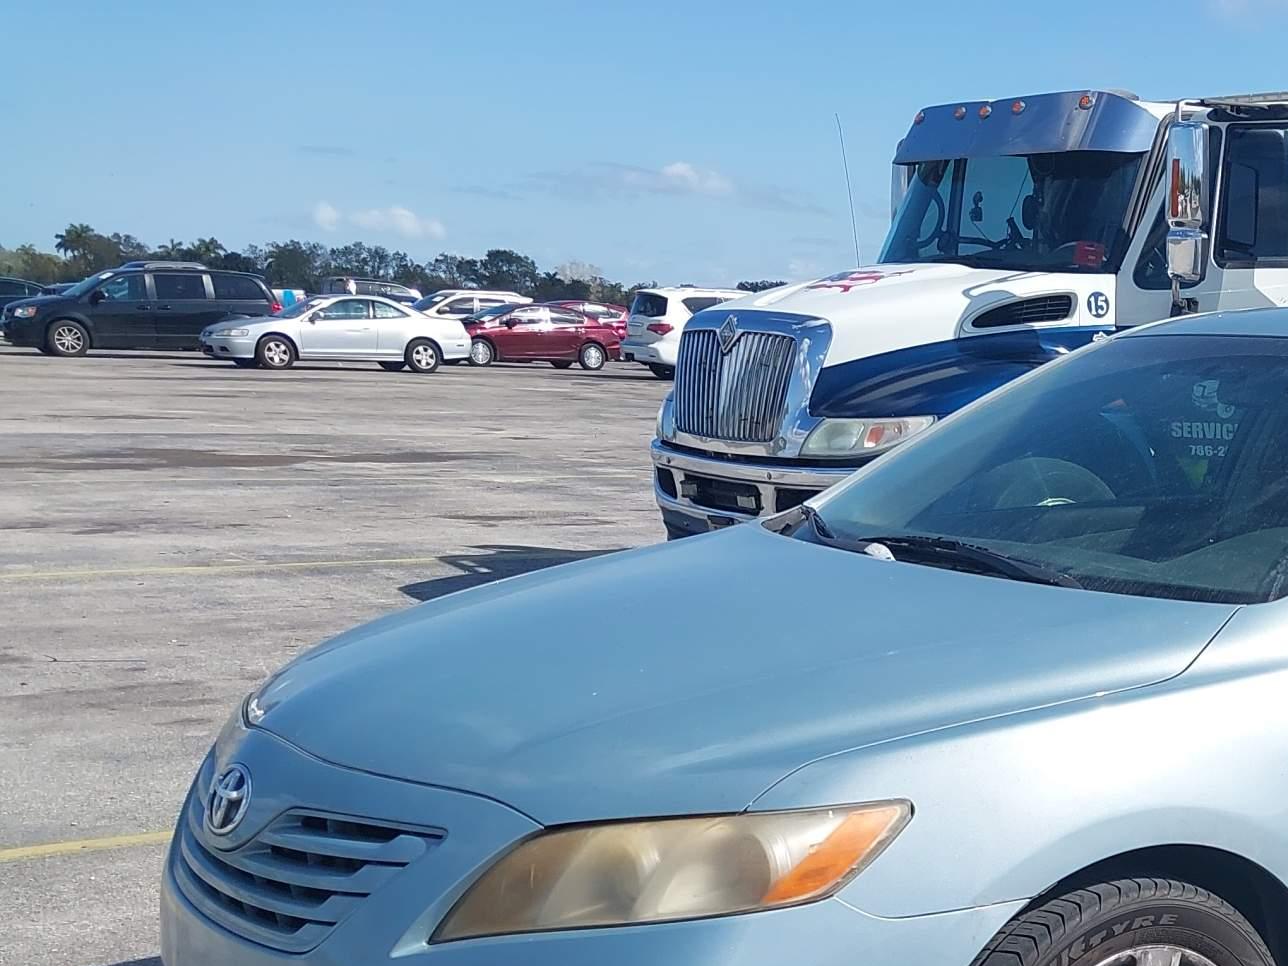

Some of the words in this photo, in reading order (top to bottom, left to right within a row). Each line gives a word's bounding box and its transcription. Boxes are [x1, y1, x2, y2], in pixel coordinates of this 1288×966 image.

[1089, 295, 1107, 315] 15
[1171, 422, 1238, 440] SERVIC
[1189, 444, 1228, 456] 786-2
